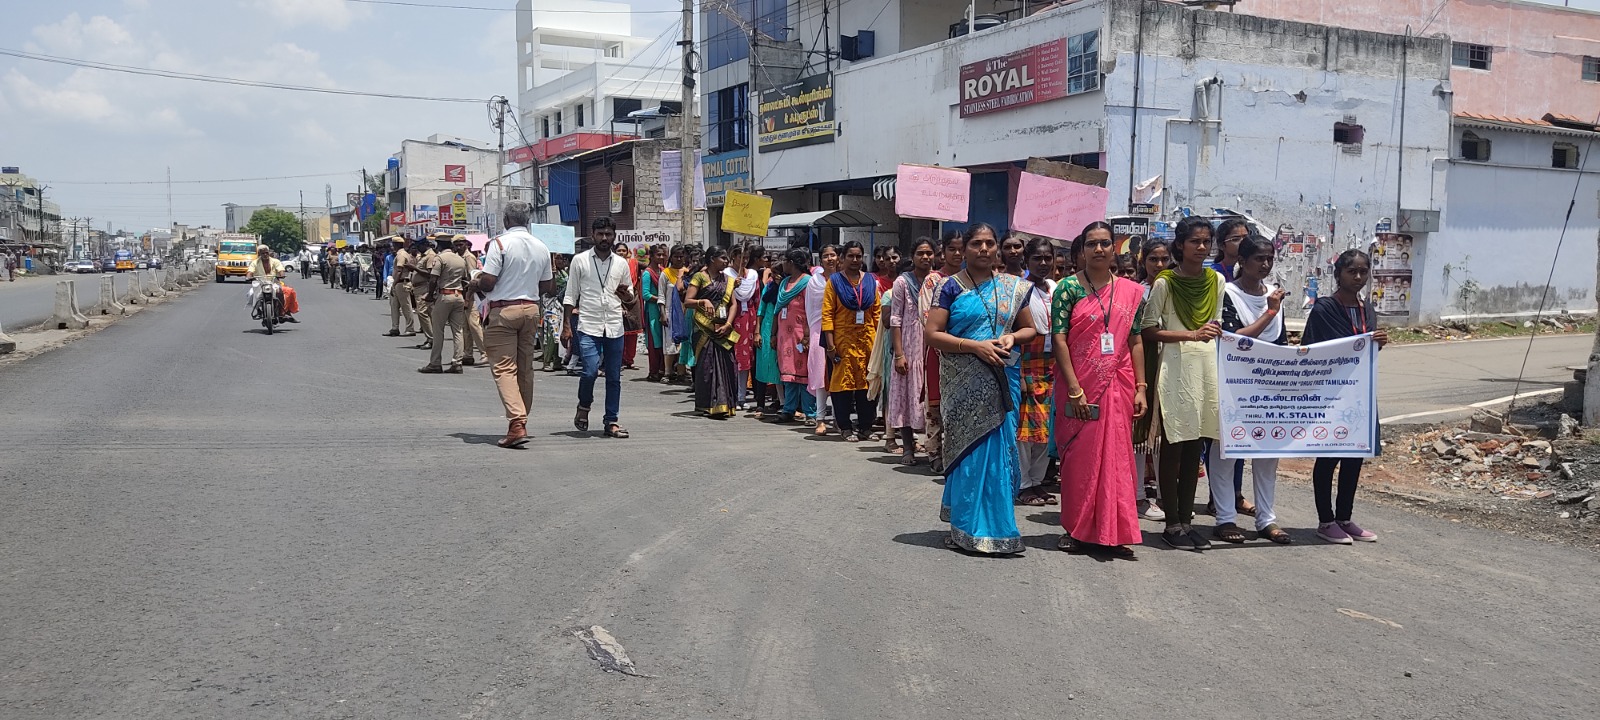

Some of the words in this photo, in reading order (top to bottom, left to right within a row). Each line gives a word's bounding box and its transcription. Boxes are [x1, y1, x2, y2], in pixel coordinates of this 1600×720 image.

[992, 59, 1008, 71] The
[964, 65, 1035, 100] ROYAL
[963, 100, 987, 115] STAINLESS
[986, 97, 1001, 111] STEEL
[1001, 89, 1034, 107] FABRICATION
[701, 161, 725, 178] IRMAL
[1226, 353, 1256, 365] போதை
[1256, 356, 1299, 367] பொருட்கள்
[1299, 357, 1328, 367] இல்லாத
[1328, 356, 1360, 366] தமிழ்நாடு
[1251, 367, 1301, 378] விழிப்புணர்வு
[1249, 393, 1322, 404] மு.க.ஸ்டாலின்
[1265, 411, 1326, 419] M.K.STALIN
